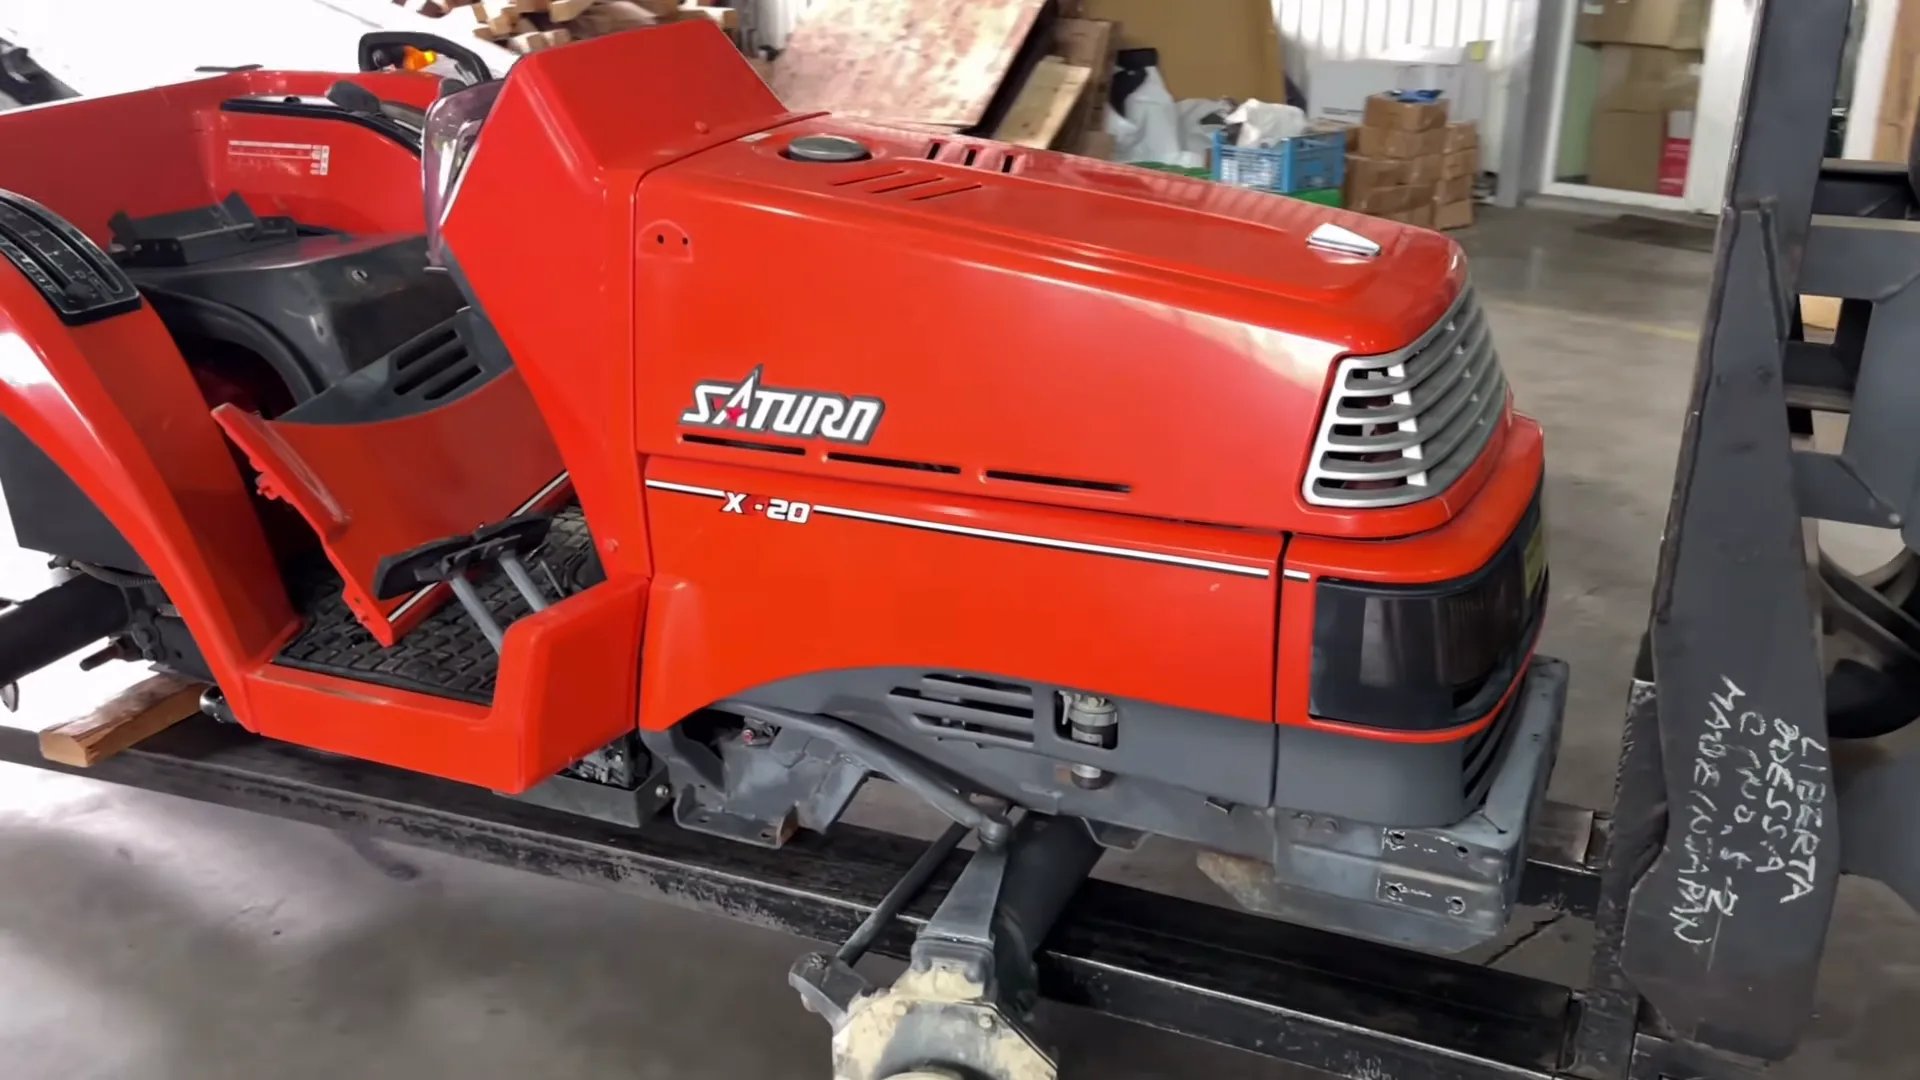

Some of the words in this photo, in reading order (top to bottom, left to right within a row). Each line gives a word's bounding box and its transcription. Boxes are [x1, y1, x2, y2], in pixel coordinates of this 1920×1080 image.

[679, 365, 885, 444] SATURN
[1755, 717, 1800, 873] ODESSA
[1780, 736, 1827, 904] LIBERTA
